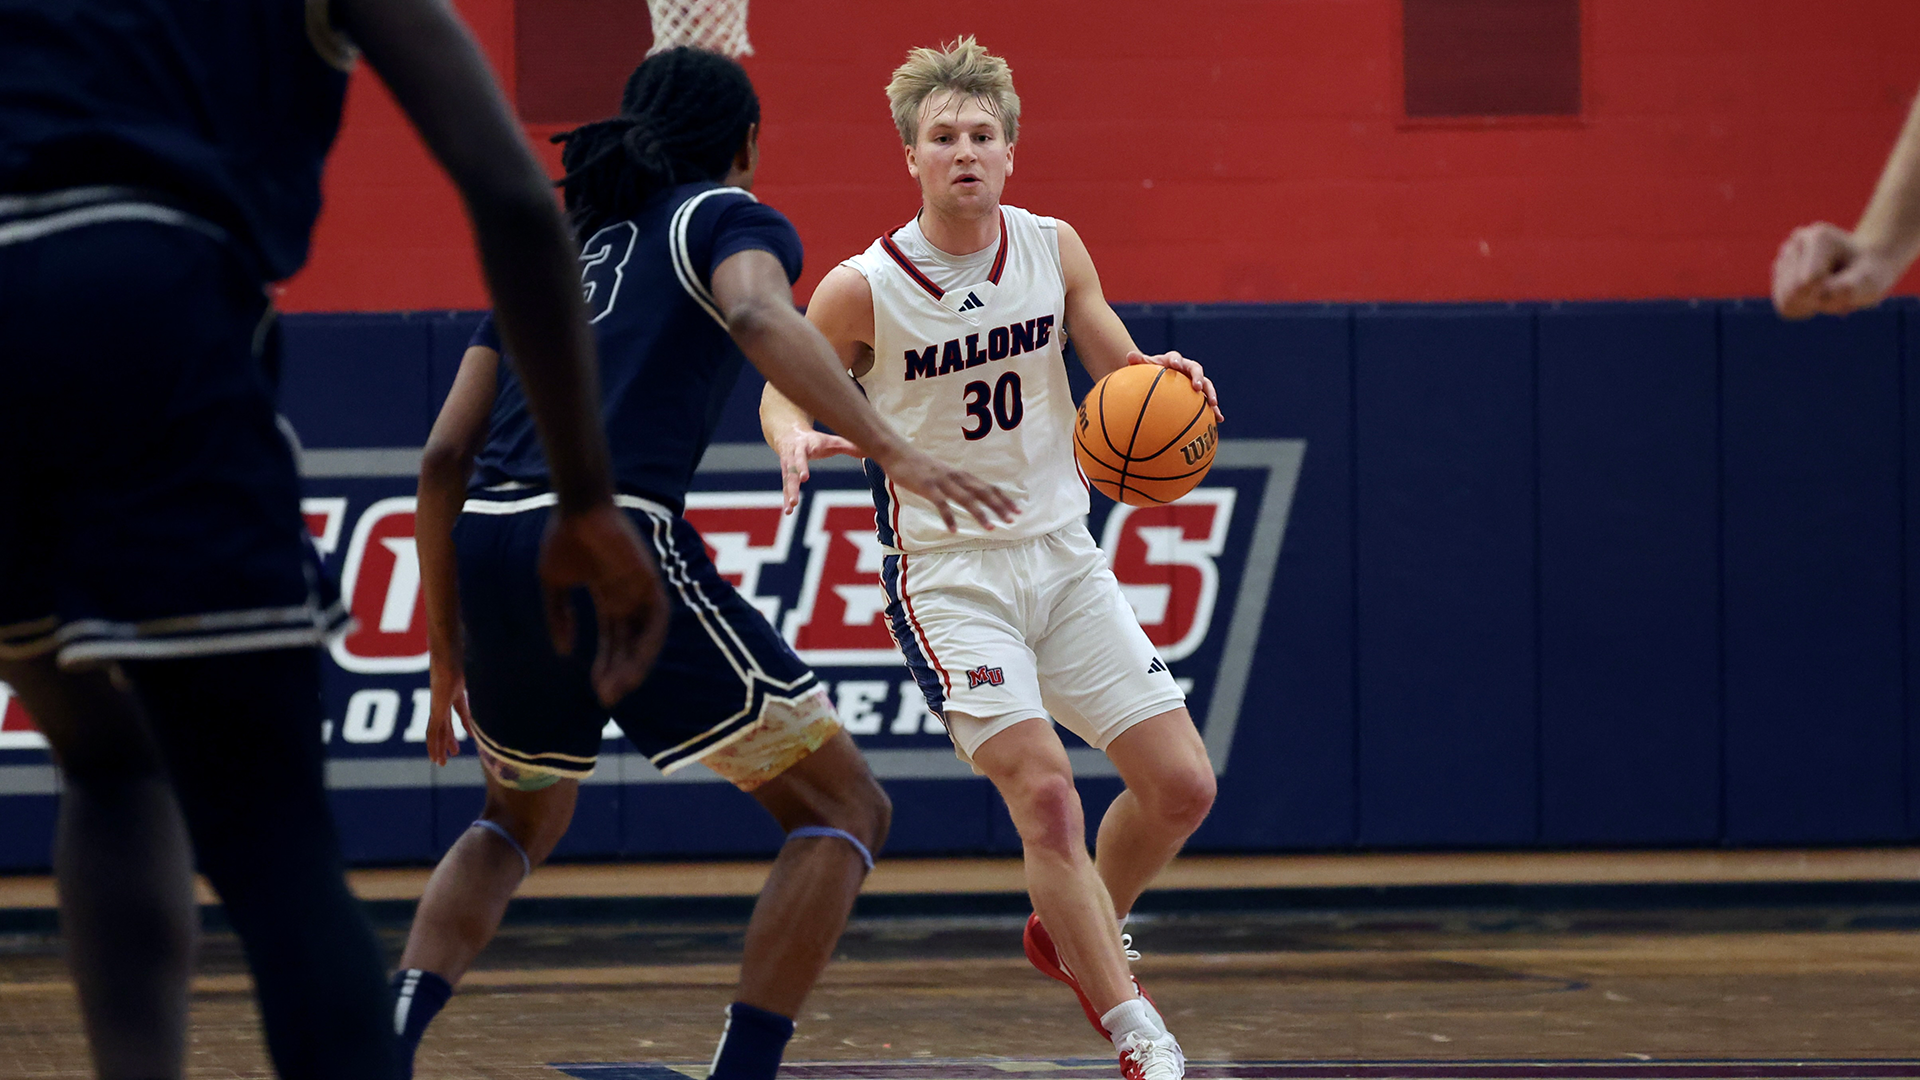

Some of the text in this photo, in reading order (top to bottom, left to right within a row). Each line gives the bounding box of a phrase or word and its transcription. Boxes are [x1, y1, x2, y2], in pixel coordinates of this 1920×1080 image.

[904, 314, 1055, 381] MALONE
[962, 371, 1024, 441] 30
[1180, 423, 1218, 466] Wil
[966, 664, 1005, 690] MU
